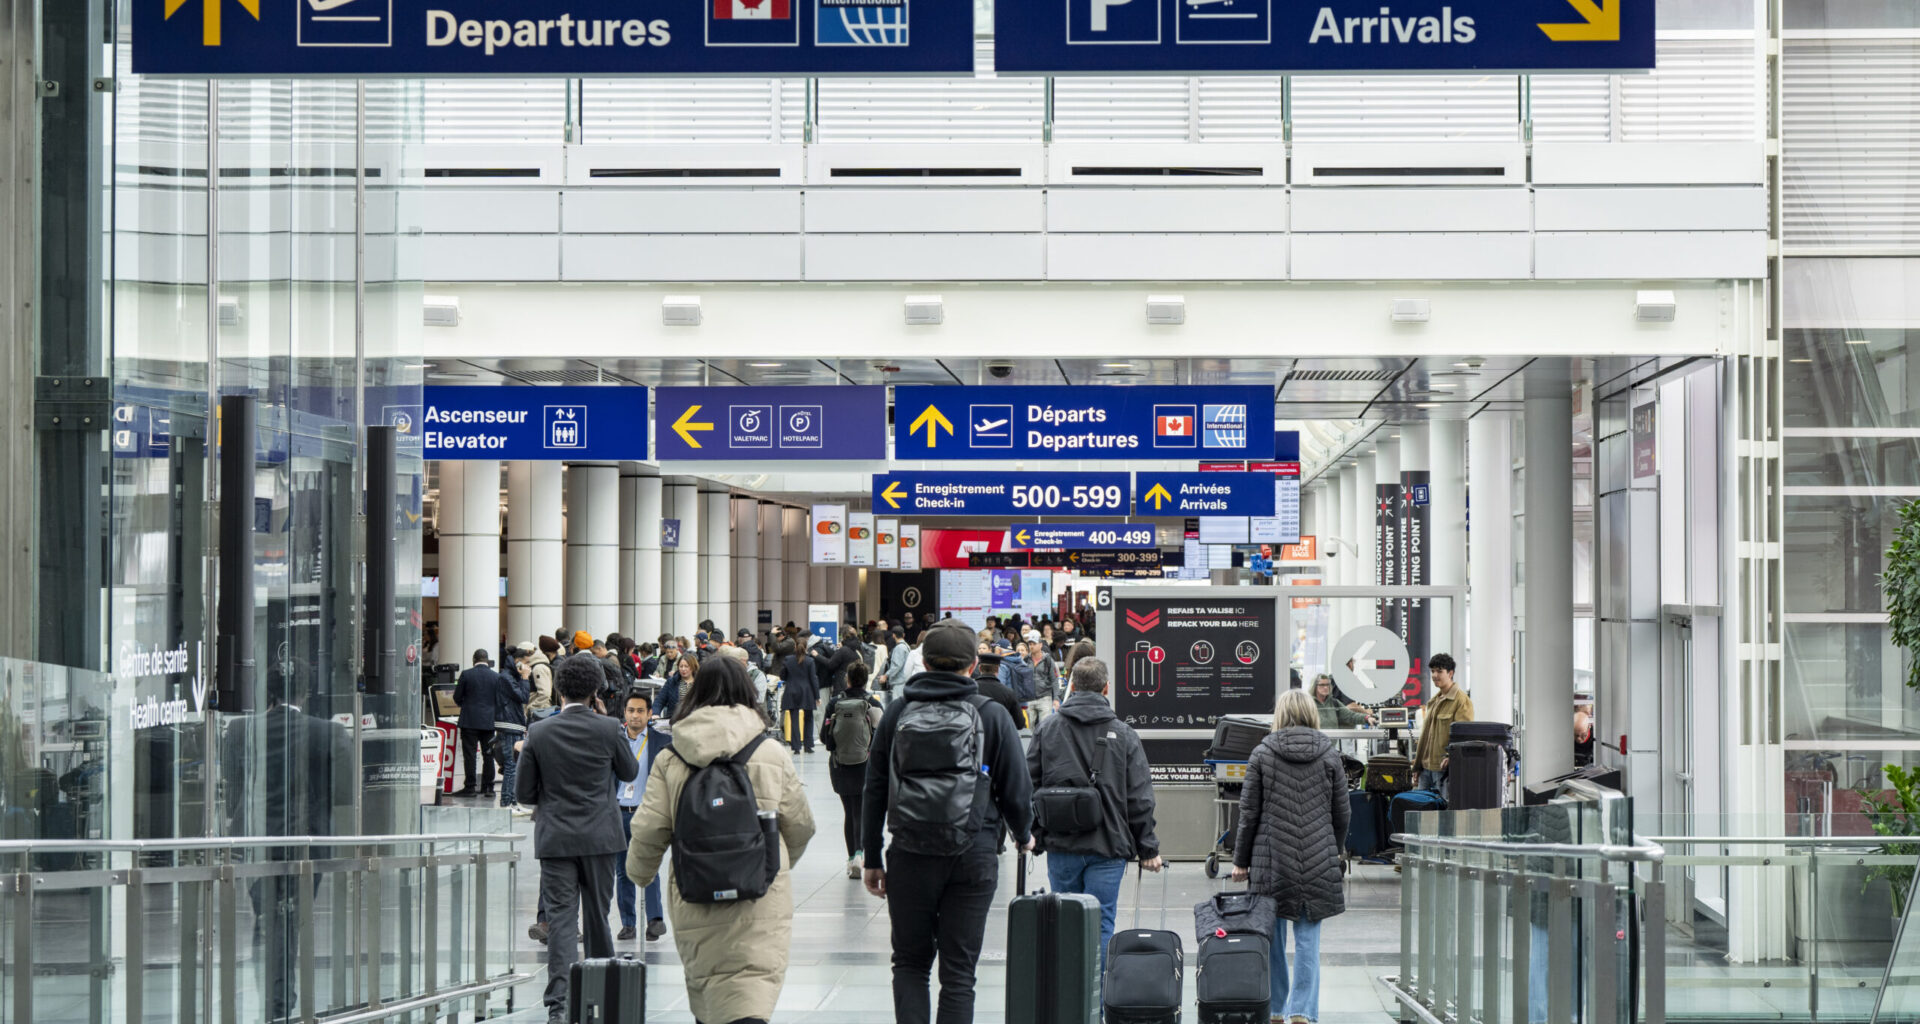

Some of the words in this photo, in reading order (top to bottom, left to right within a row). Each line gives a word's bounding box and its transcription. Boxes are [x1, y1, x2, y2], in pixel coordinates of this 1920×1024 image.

[427, 10, 670, 55] Departures
[1309, 7, 1476, 43] Arrivals
[425, 406, 528, 423] Ascenseur
[1028, 405, 1106, 425] Départs
[425, 432, 507, 448] Elevator
[1028, 431, 1138, 451] Departures
[916, 483, 1004, 495] Enregistrement
[1013, 486, 1120, 508] 500-599
[1180, 484, 1231, 494] Arrivées
[916, 497, 964, 507] Check-in
[1180, 499, 1227, 509] Arrivals
[1034, 531, 1084, 539] Enregistrement
[1089, 531, 1150, 544] 400-499
[1385, 525, 1394, 557] POINT
[1411, 517, 1420, 554] POINT
[1117, 553, 1158, 562] 300-399
[1385, 560, 1394, 606] MTING
[1411, 556, 1420, 607] MTING
[1098, 591, 1110, 605] 6
[120, 646, 150, 678] Centre
[151, 643, 163, 675] de
[164, 641, 188, 674] santé
[130, 695, 159, 730] Health
[161, 699, 187, 725] centre
